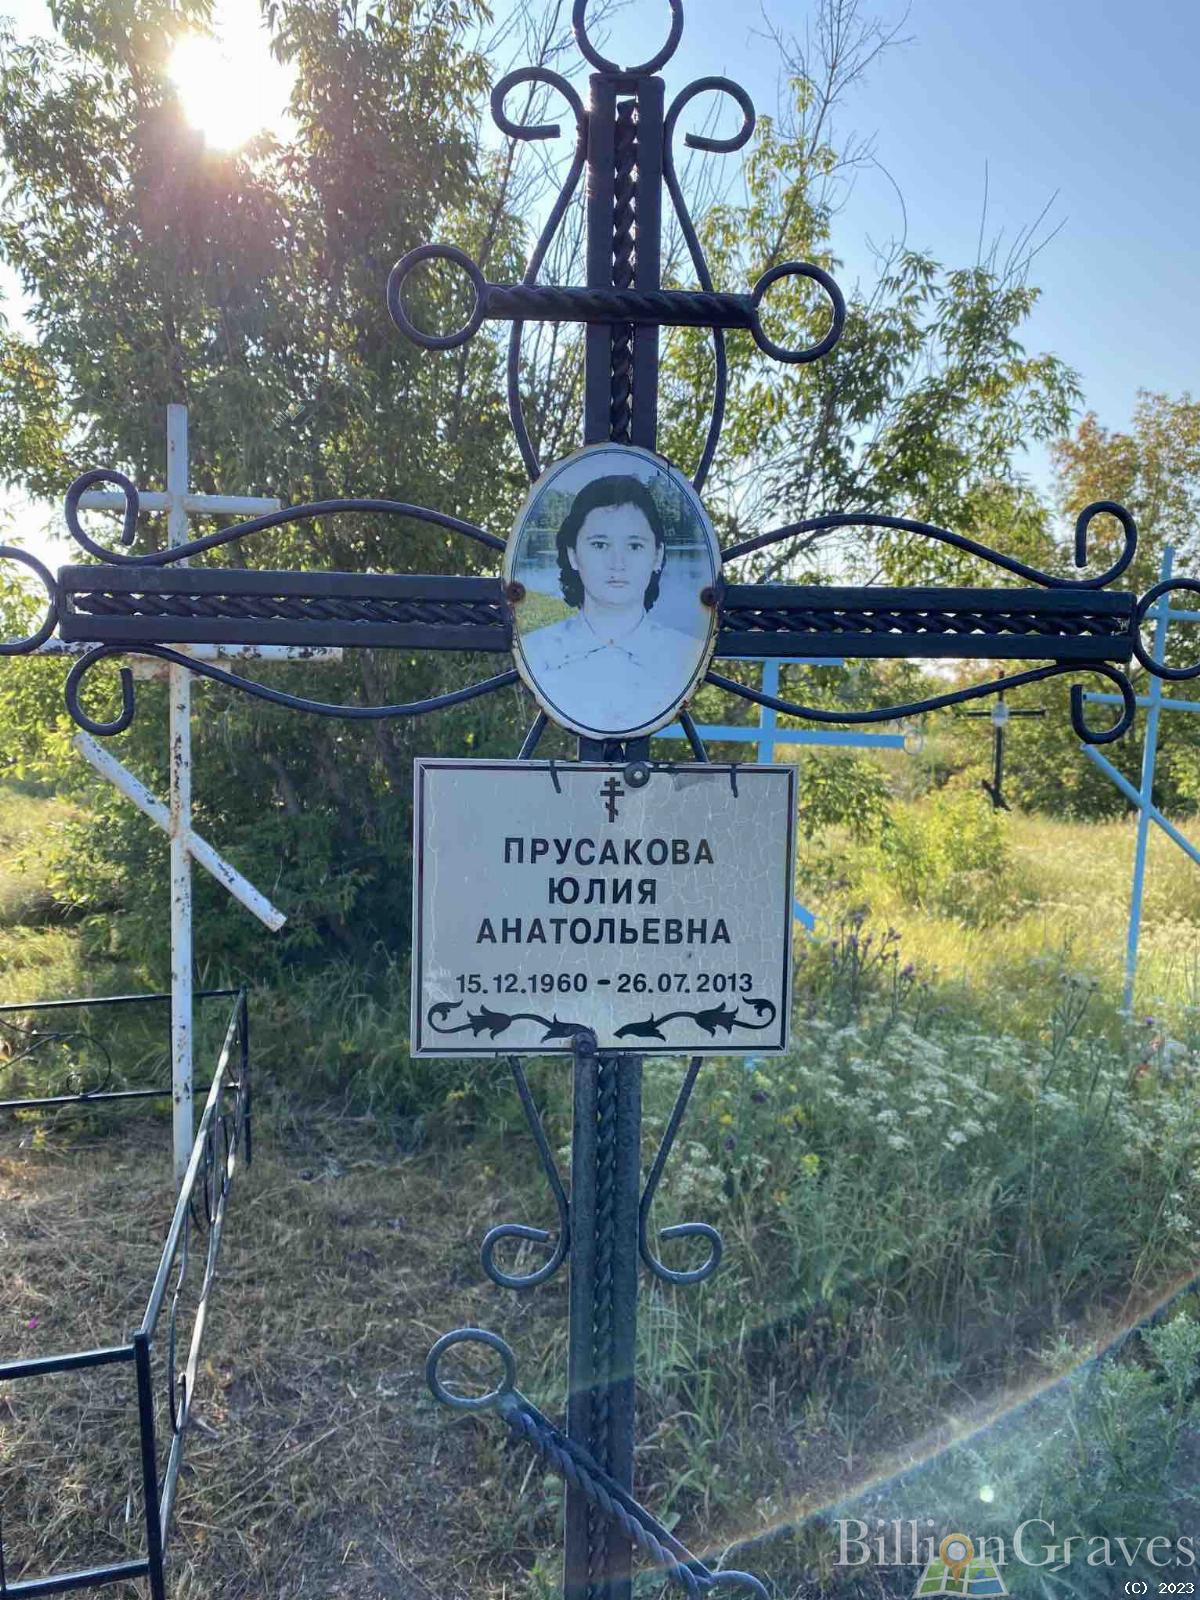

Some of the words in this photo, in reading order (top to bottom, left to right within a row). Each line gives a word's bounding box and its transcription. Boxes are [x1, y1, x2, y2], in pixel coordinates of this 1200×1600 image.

[504, 837, 714, 865] ПРУСАКОВА
[548, 877, 657, 905] ЮЛИЯ
[476, 918, 731, 945] АНАТОЛЬЕВНА
[455, 973, 588, 994] 15.12.1960
[617, 973, 753, 993] 26.07.2013
